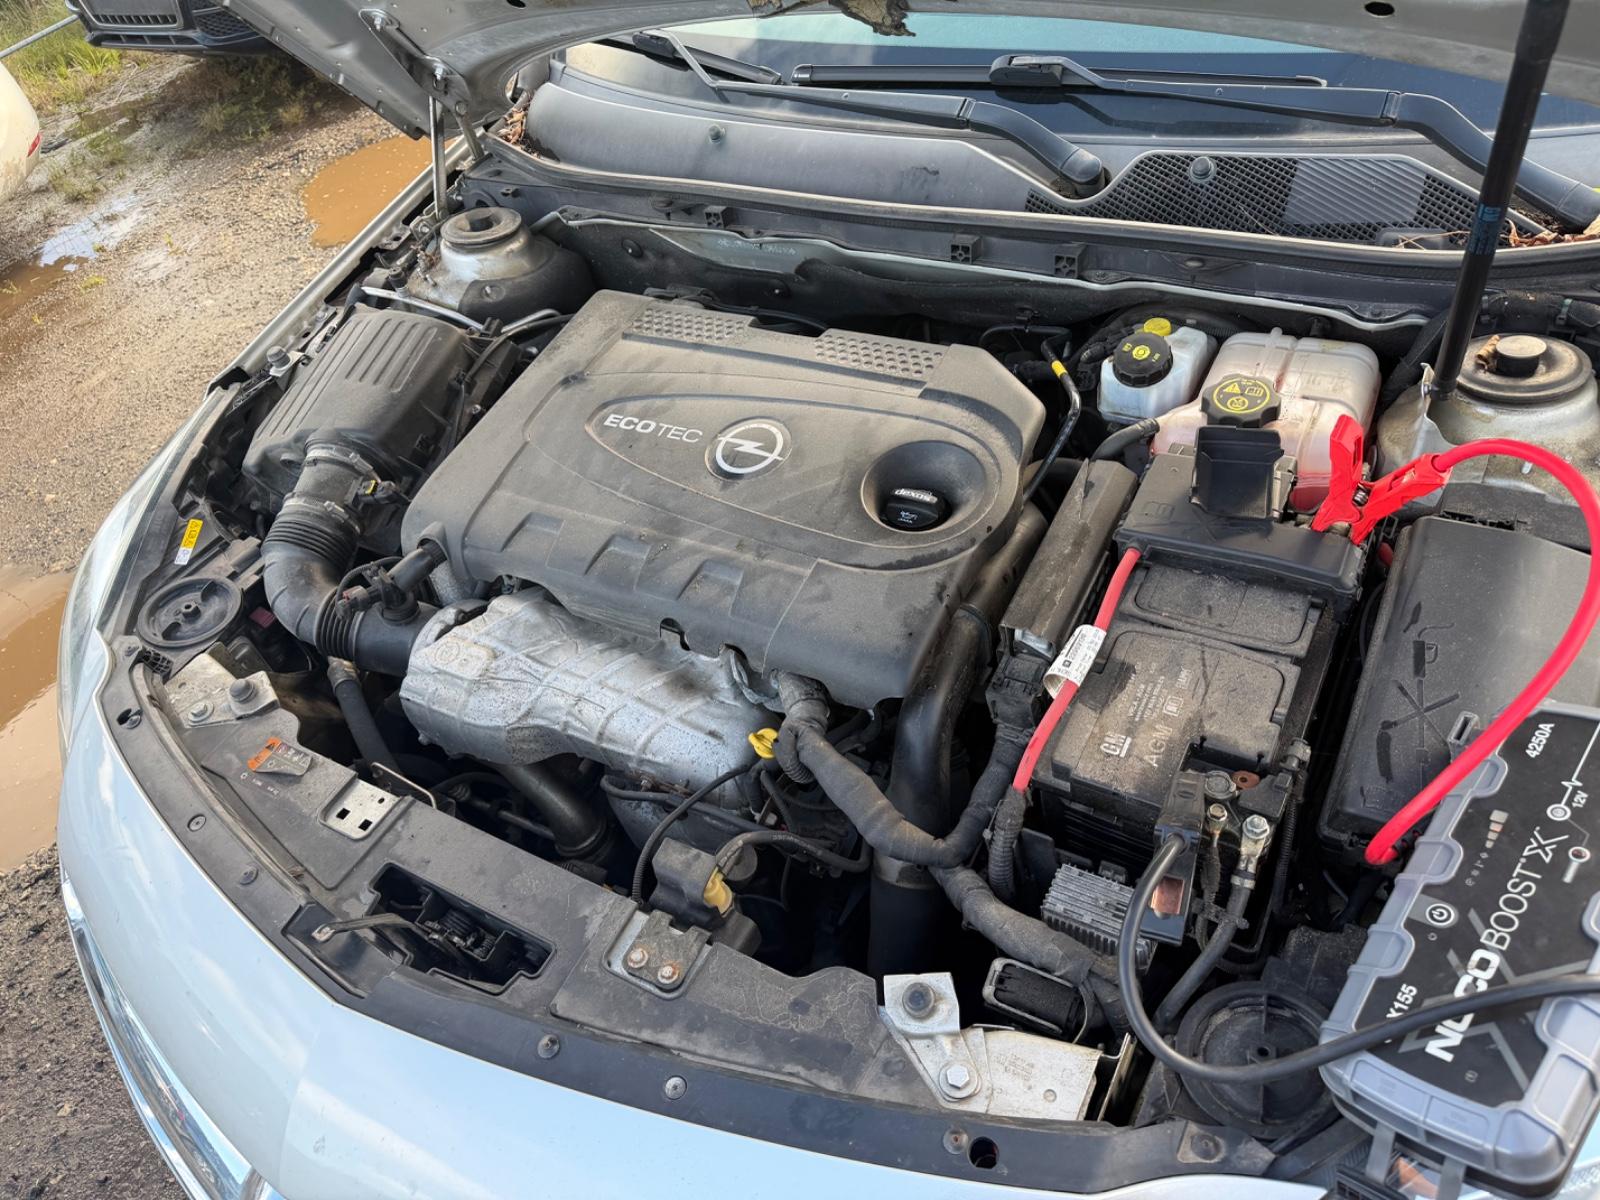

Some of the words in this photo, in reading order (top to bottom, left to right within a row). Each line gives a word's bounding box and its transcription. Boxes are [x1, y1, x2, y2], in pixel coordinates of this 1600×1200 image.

[604, 413, 703, 443] ECOTEC
[1525, 722, 1554, 759] 4250A
[1571, 790, 1589, 810] 12V
[1480, 863, 1542, 951] BOOST
